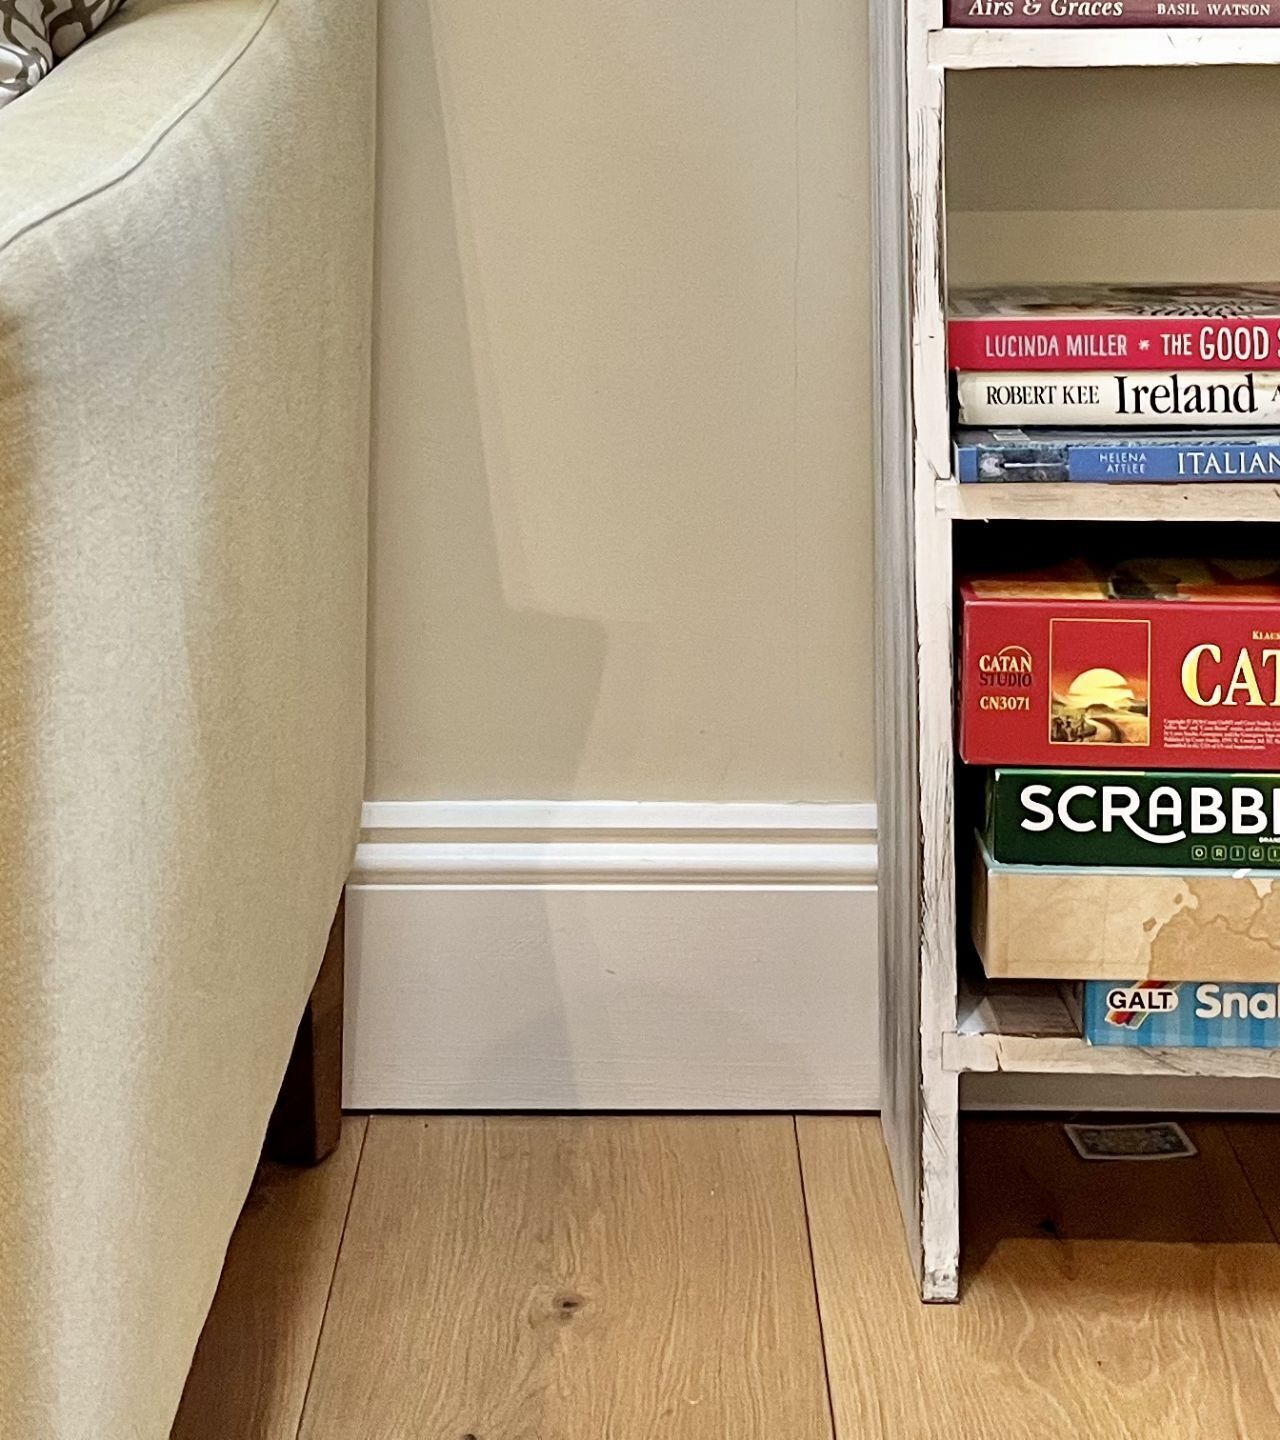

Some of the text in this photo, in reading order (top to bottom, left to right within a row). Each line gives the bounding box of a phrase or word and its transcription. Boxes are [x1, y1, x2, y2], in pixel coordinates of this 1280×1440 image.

[1157, 3, 1200, 16] BASIL
[1207, 3, 1271, 16] WATSON
[985, 334, 1061, 358] LUCINDA
[1066, 334, 1128, 357] MILLER
[1160, 332, 1193, 357] THE
[1199, 325, 1270, 361] GOOD
[985, 385, 1057, 406] ROBERT
[1062, 385, 1100, 406] KEE
[1115, 373, 1258, 415] Ireland
[1099, 453, 1147, 463] HELENA
[1106, 463, 1146, 474] ATTLEE
[978, 654, 1033, 673] CATAN
[978, 672, 1033, 688] STUDIO
[979, 696, 1030, 711] CN3071
[1108, 990, 1174, 1010] GALT
